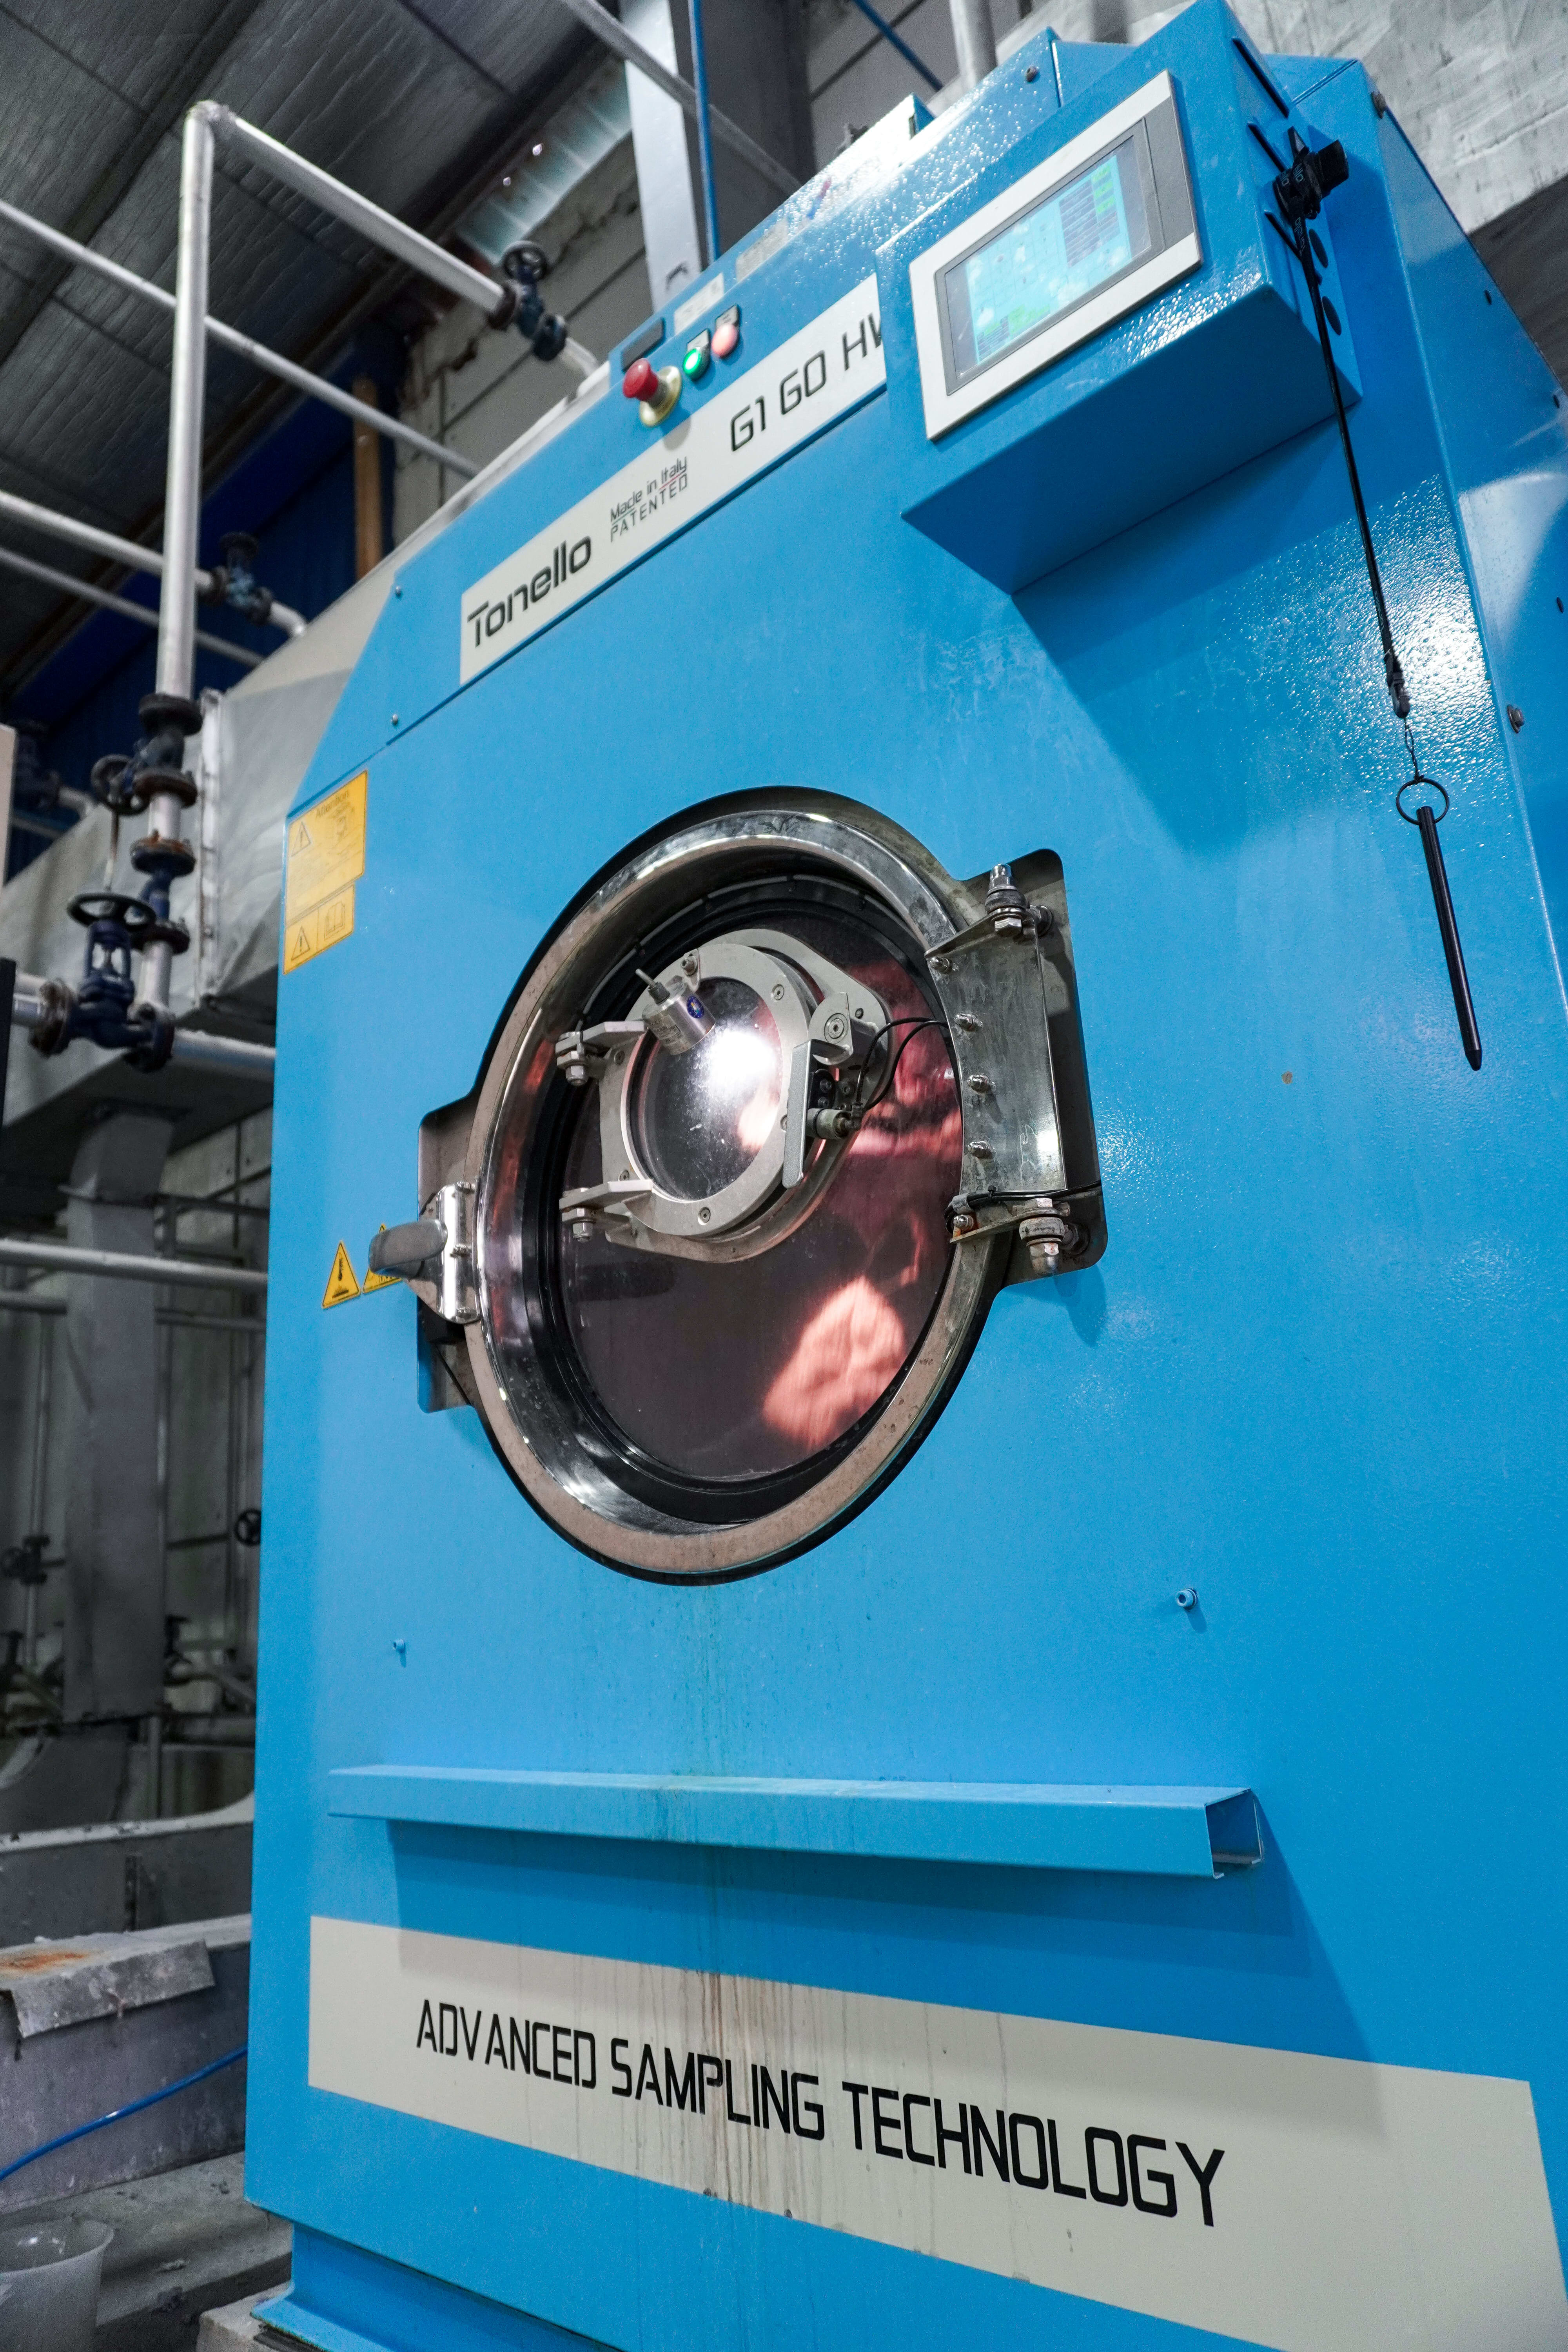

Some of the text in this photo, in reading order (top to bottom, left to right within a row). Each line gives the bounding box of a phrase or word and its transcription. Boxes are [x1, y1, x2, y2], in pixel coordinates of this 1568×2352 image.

[730, 395, 766, 452] G1
[610, 456, 687, 523] Made in Italy
[610, 473, 688, 543] PATENTED
[467, 535, 592, 647] Tonello
[417, 1999, 1225, 2227] ADVANCED SAMPLING TECHNOLOGY
